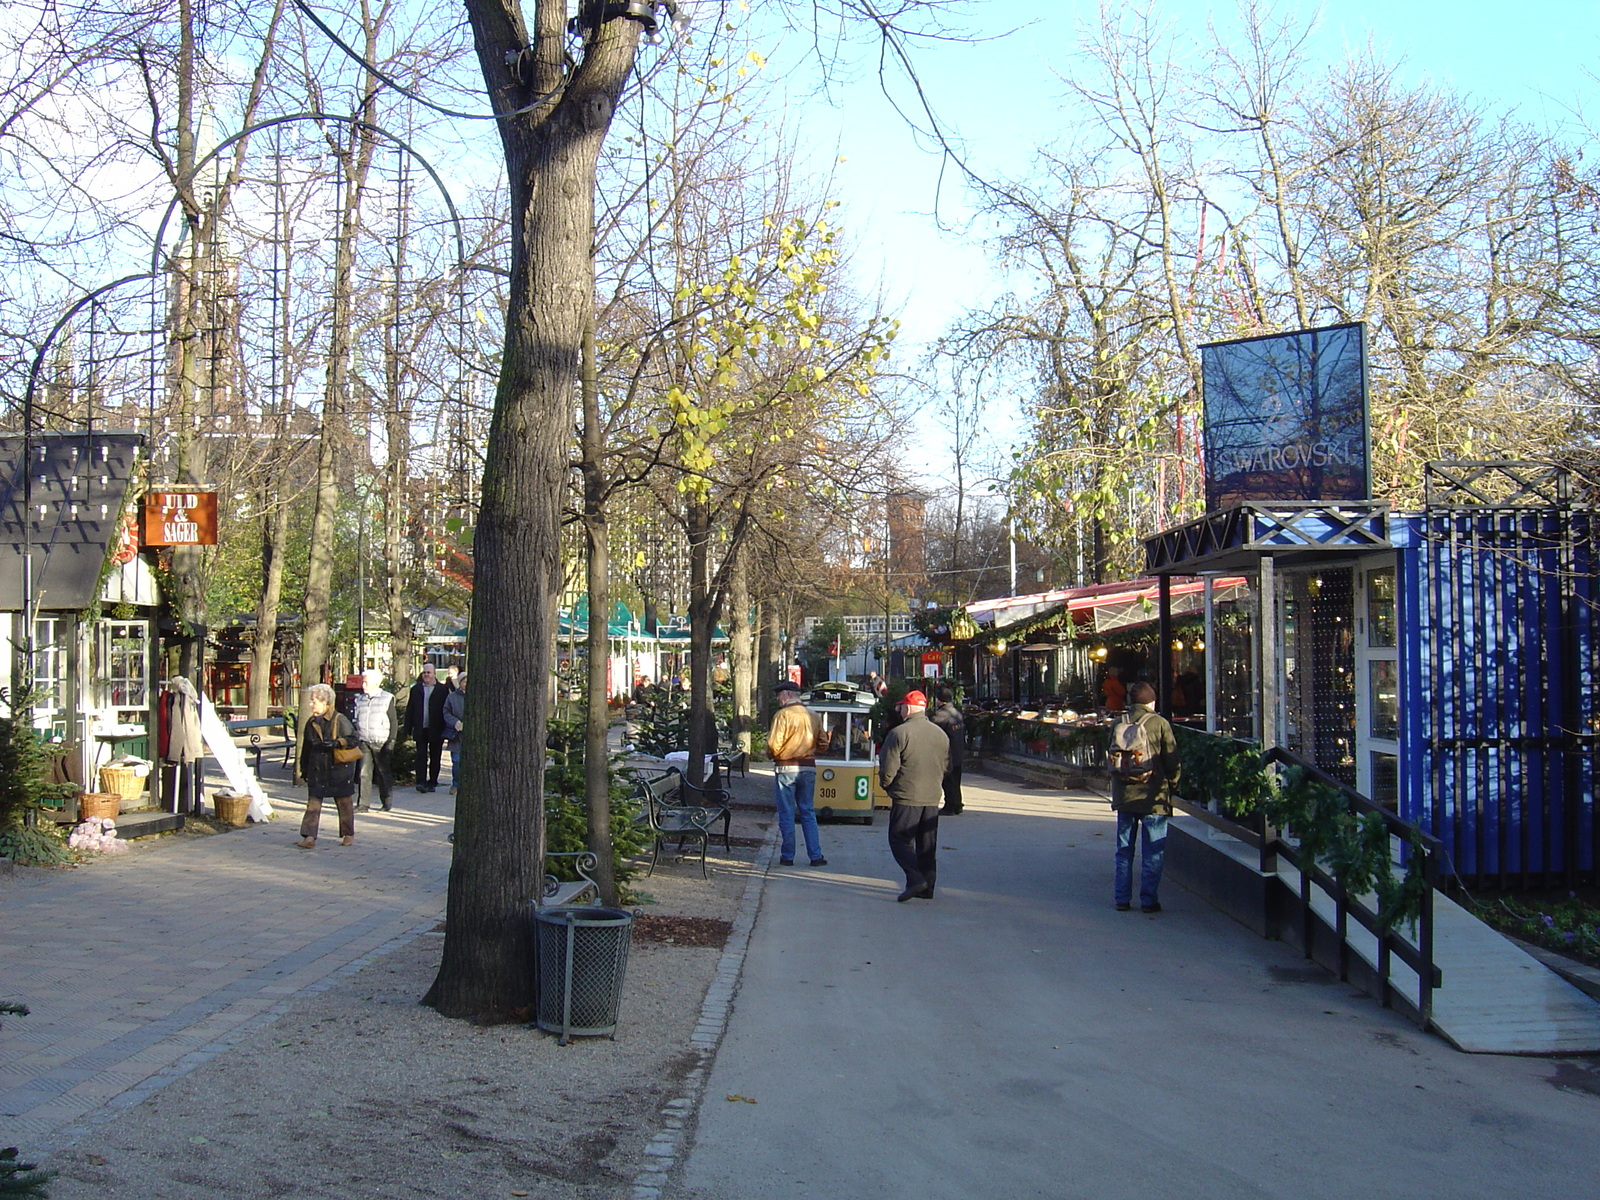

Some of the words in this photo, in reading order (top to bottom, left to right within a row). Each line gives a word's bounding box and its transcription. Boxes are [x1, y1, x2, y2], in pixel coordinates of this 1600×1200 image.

[1219, 439, 1355, 473] SWAROVSKI
[174, 509, 189, 522] &
[164, 522, 199, 542] SAGER
[820, 788, 836, 798] 309
[857, 778, 868, 797] 8
